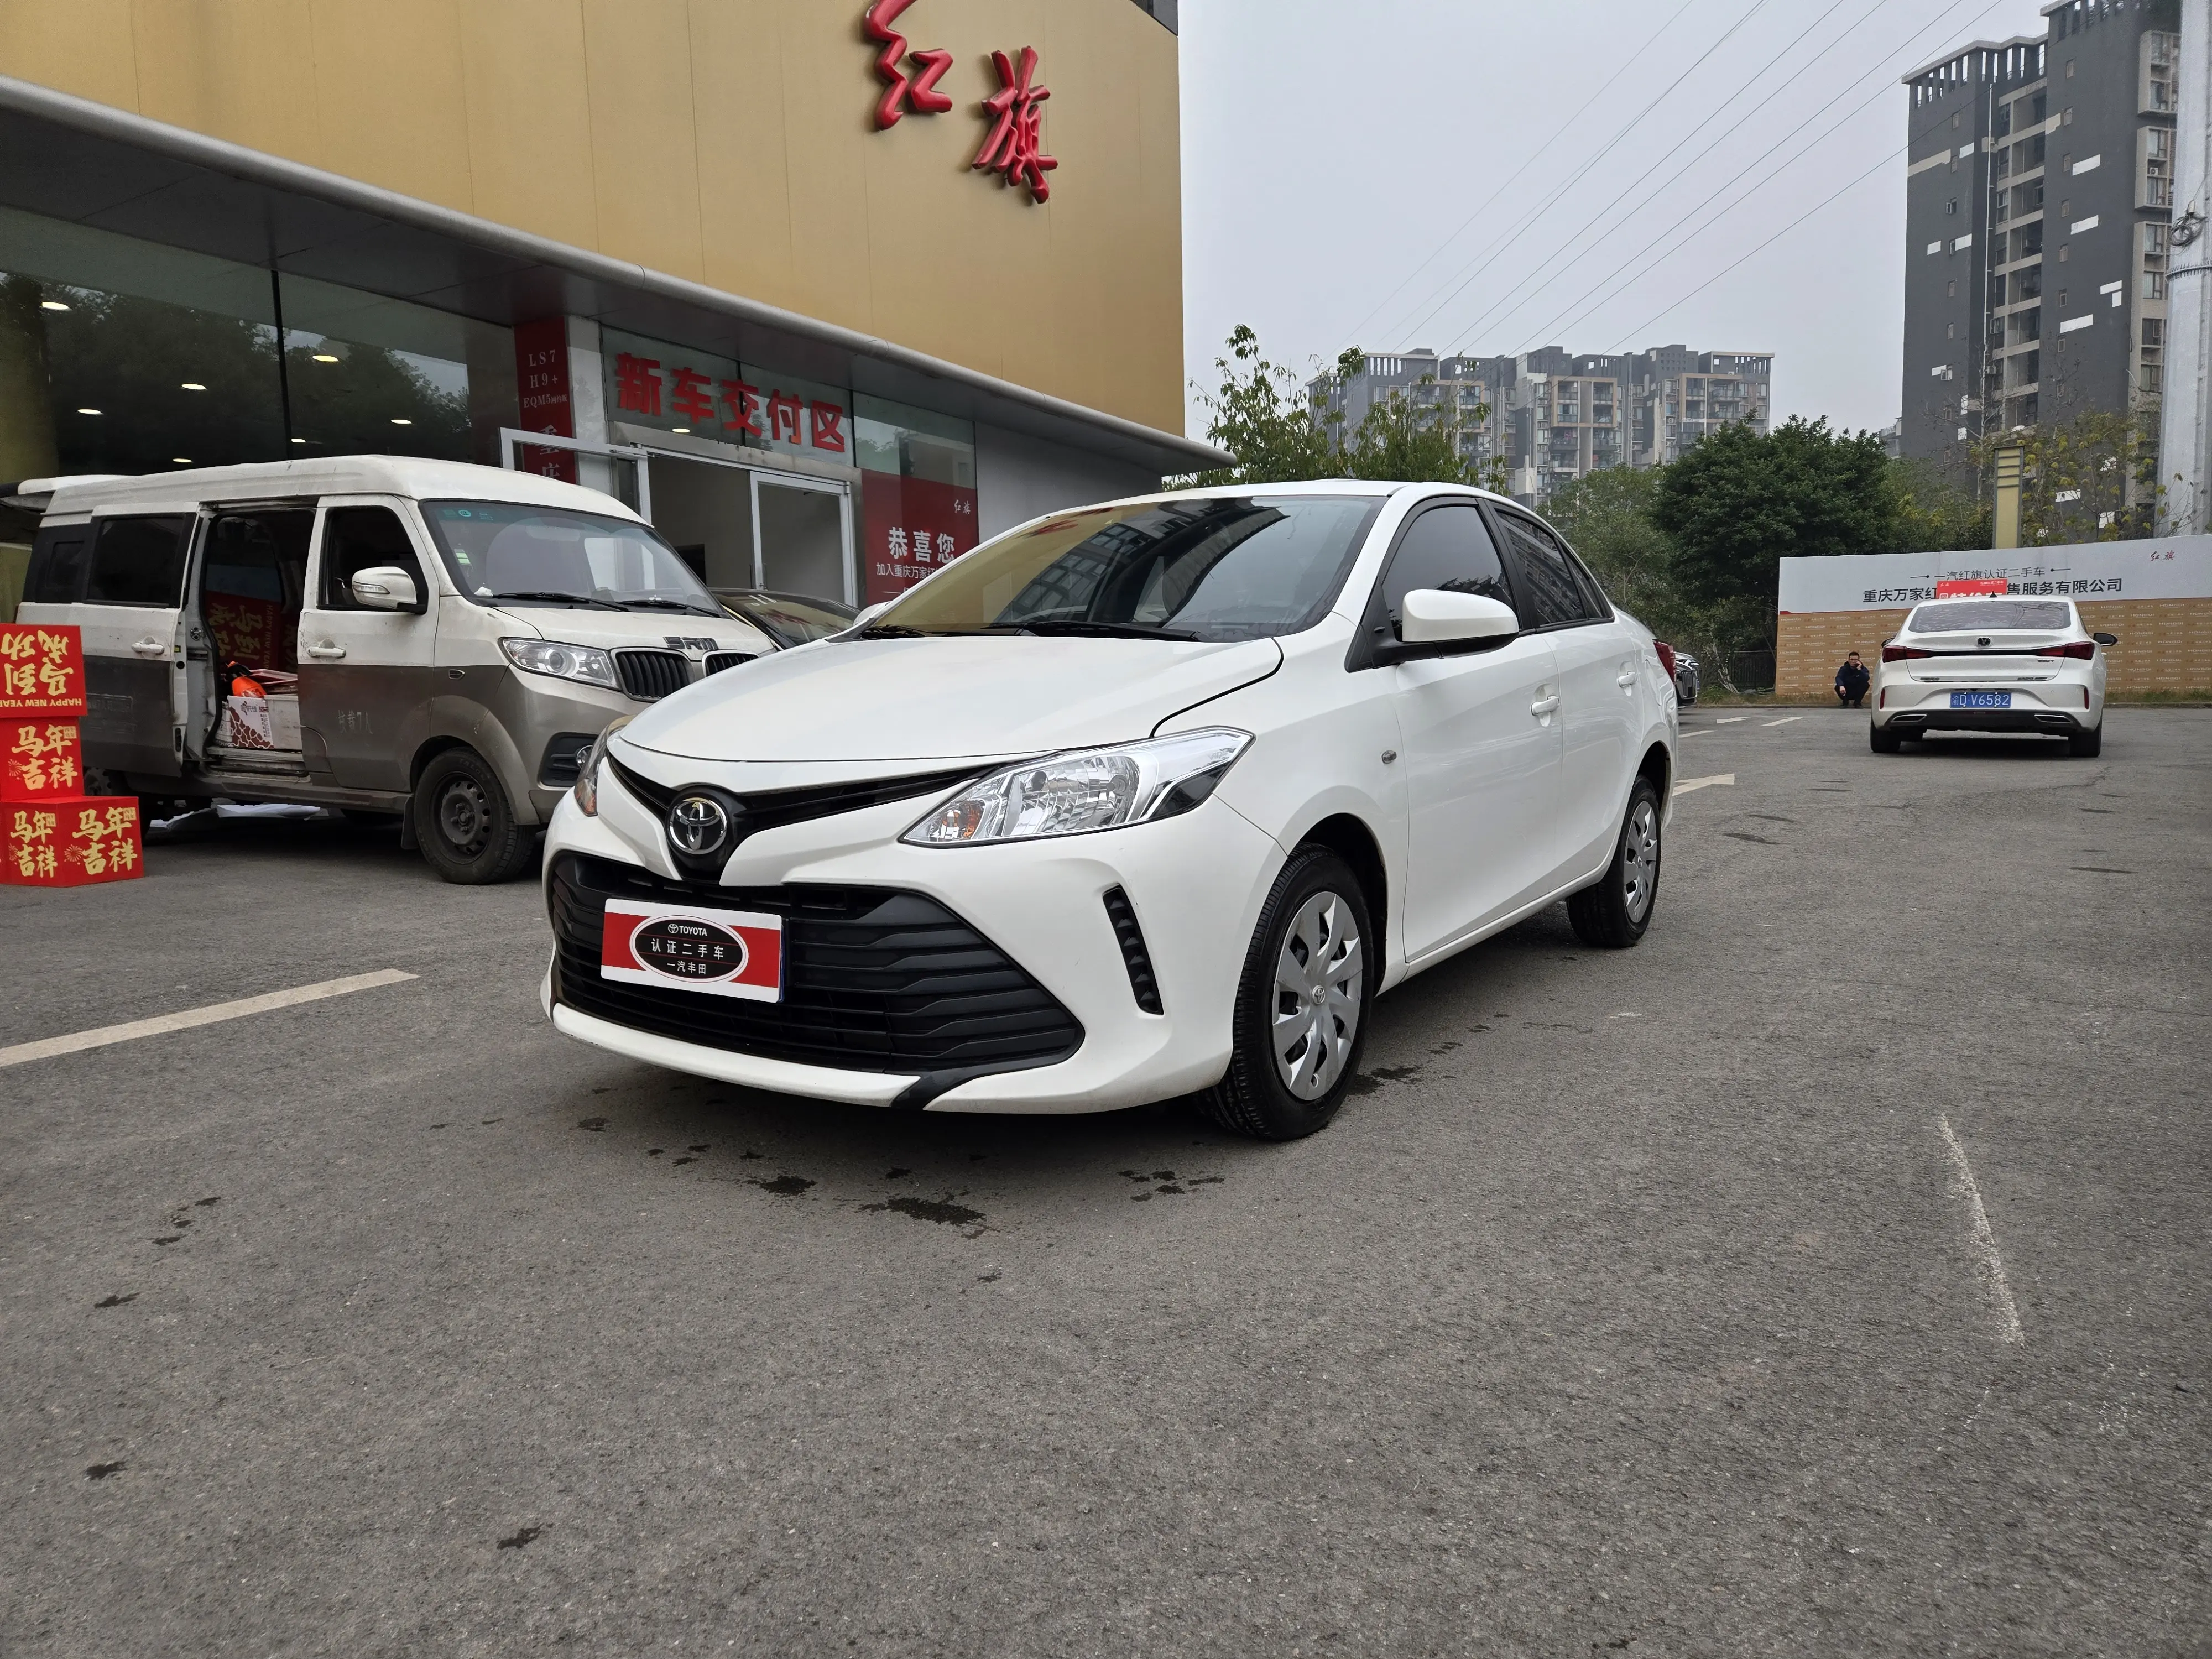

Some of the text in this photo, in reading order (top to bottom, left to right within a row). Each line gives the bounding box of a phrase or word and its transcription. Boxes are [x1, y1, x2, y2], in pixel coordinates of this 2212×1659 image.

[529, 349, 556, 367] LS7
[529, 373, 559, 388] H9+
[615, 352, 846, 452] 新车交付区
[954, 499, 971, 515] 红旗
[888, 526, 956, 564] 恭喜您
[2150, 550, 2176, 561] 红旗
[1934, 566, 2046, 581] 一汽红旗认证二手车
[25, 698, 48, 707] NEW
[50, 698, 82, 706] HAPPY
[11, 724, 72, 758] 马年
[21, 755, 78, 790] 吉祥
[10, 810, 54, 845] 马年
[72, 806, 133, 842] 马年
[17, 844, 58, 878] 吉祥
[82, 838, 138, 875] 吉祥
[679, 925, 708, 936] TOYOTA
[651, 938, 724, 961] 认证二手车
[666, 961, 707, 975] 一汽丰田
